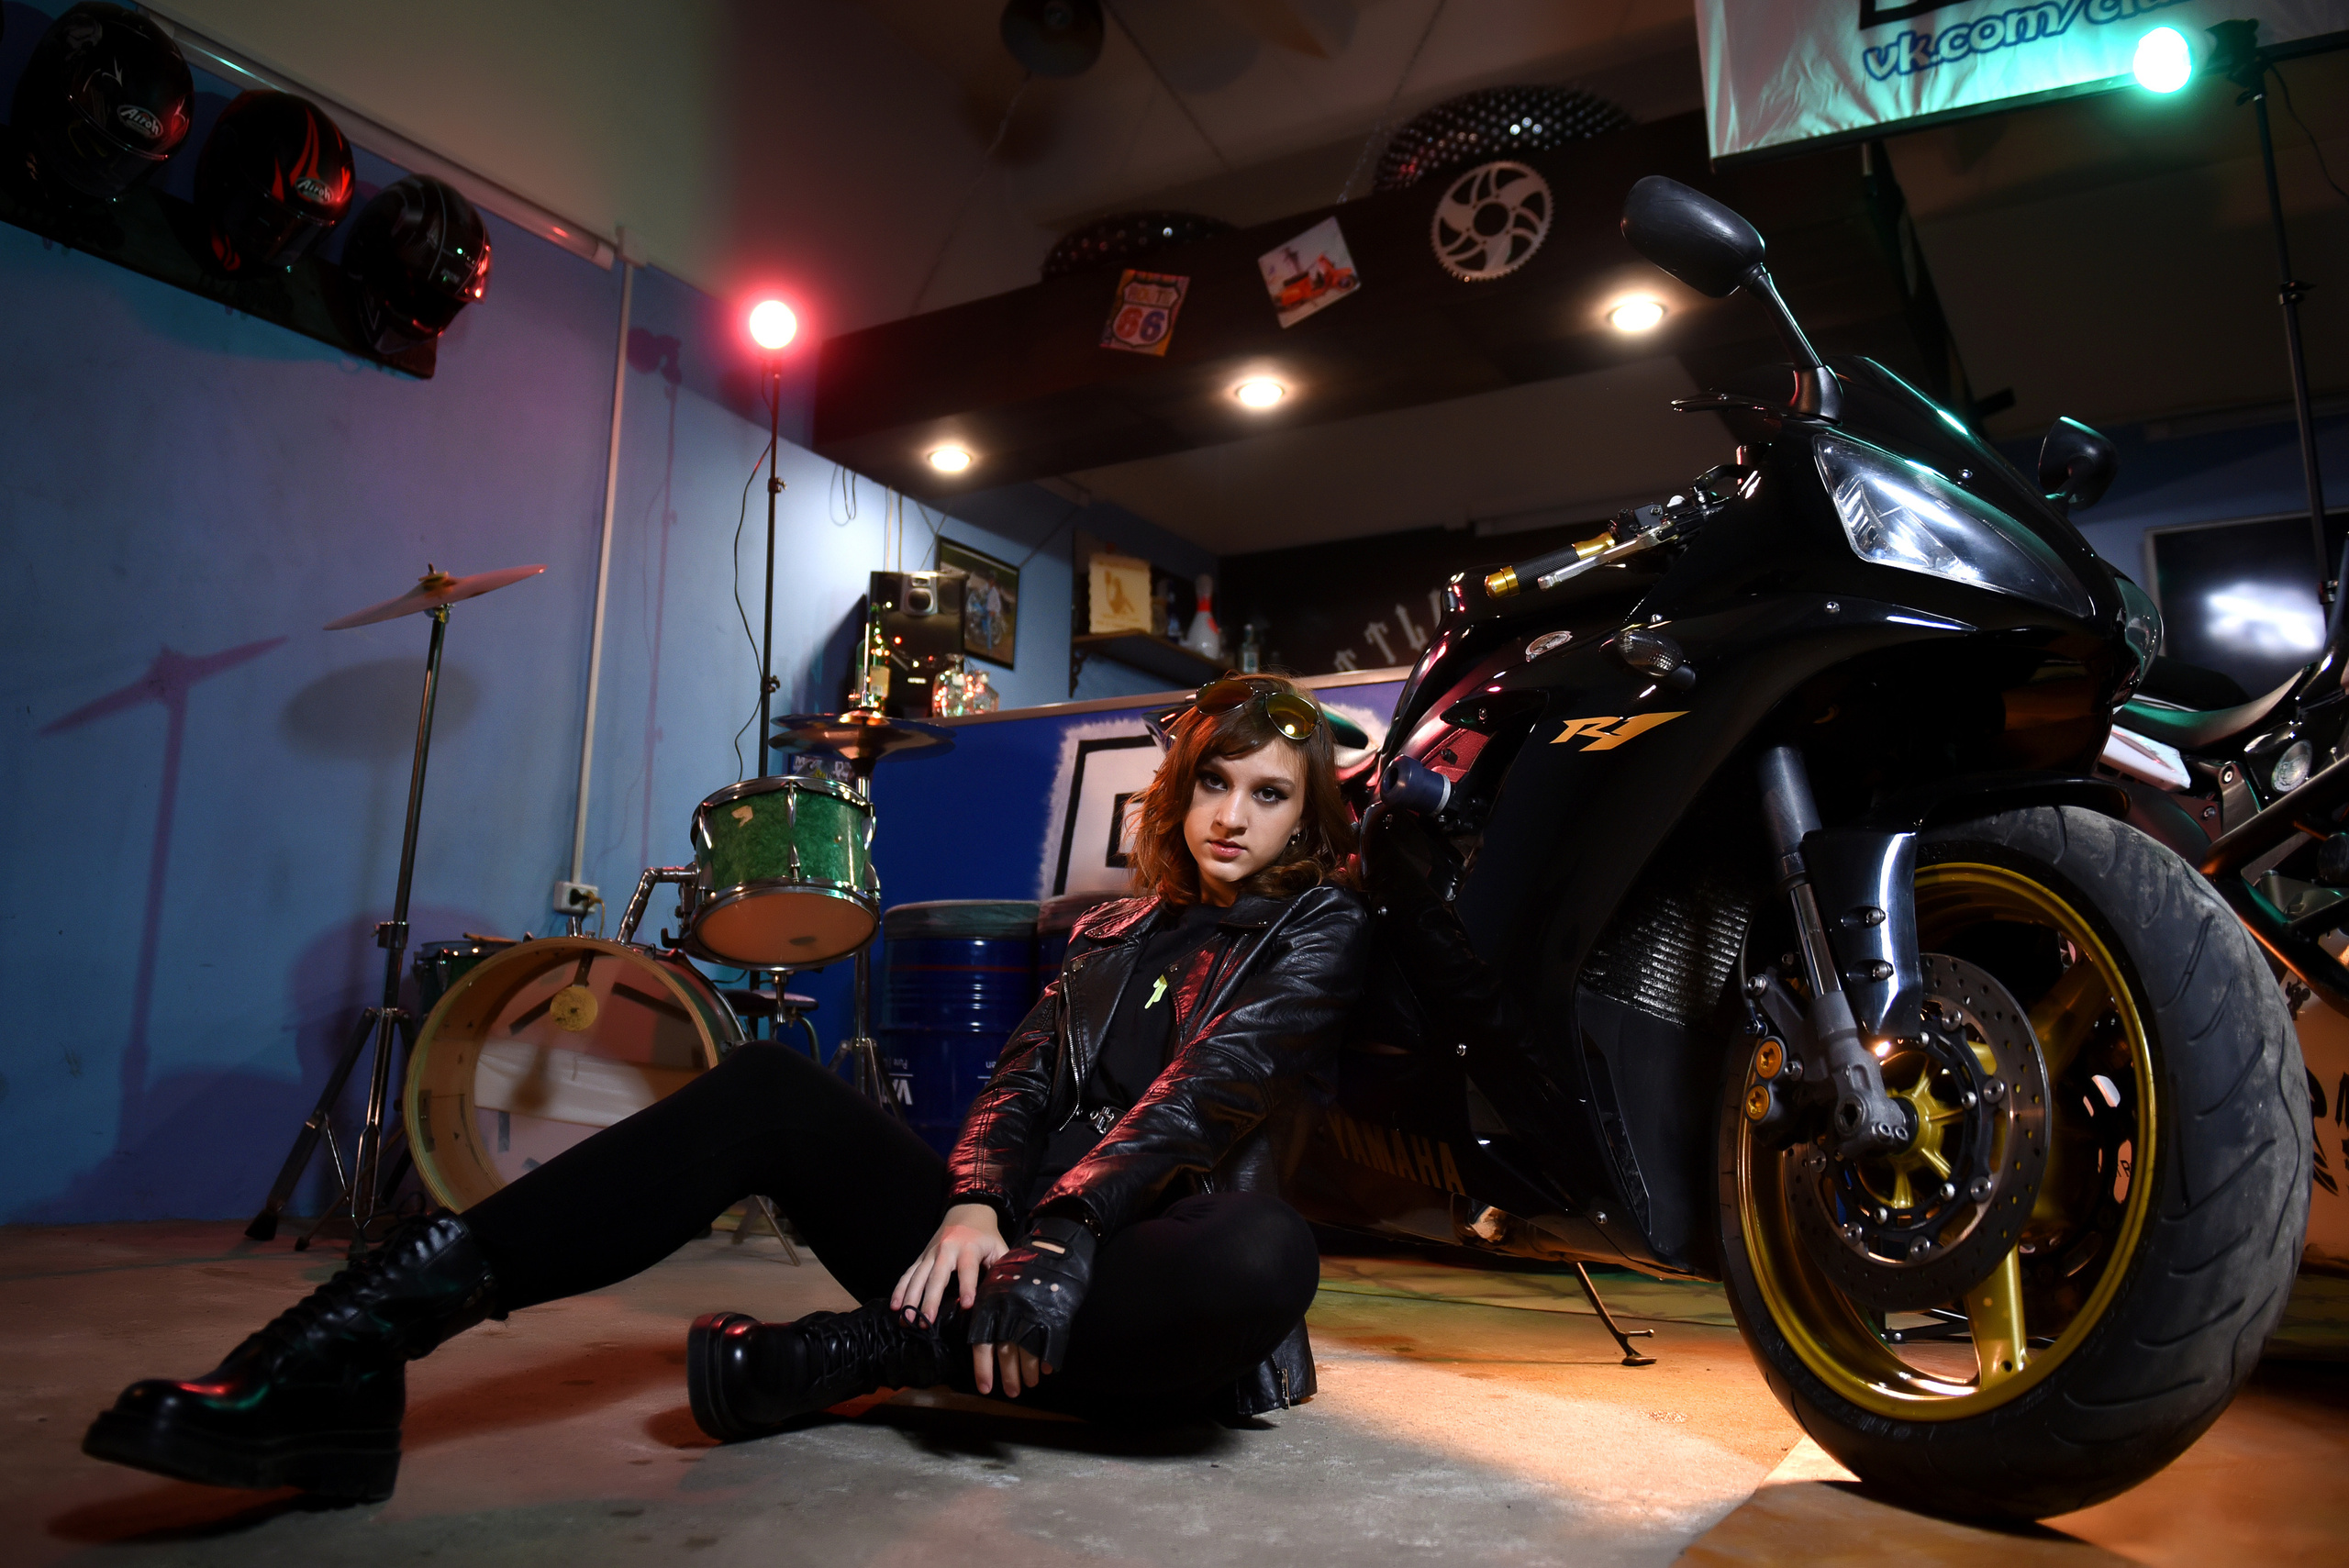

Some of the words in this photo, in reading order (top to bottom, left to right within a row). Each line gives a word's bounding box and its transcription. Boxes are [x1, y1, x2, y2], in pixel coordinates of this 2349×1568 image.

[120, 108, 160, 136] Airoh
[297, 178, 331, 202] Airoh
[1115, 306, 1165, 342] 66
[1548, 710, 1692, 752] R1
[1326, 1111, 1467, 1196] YAMAHA
